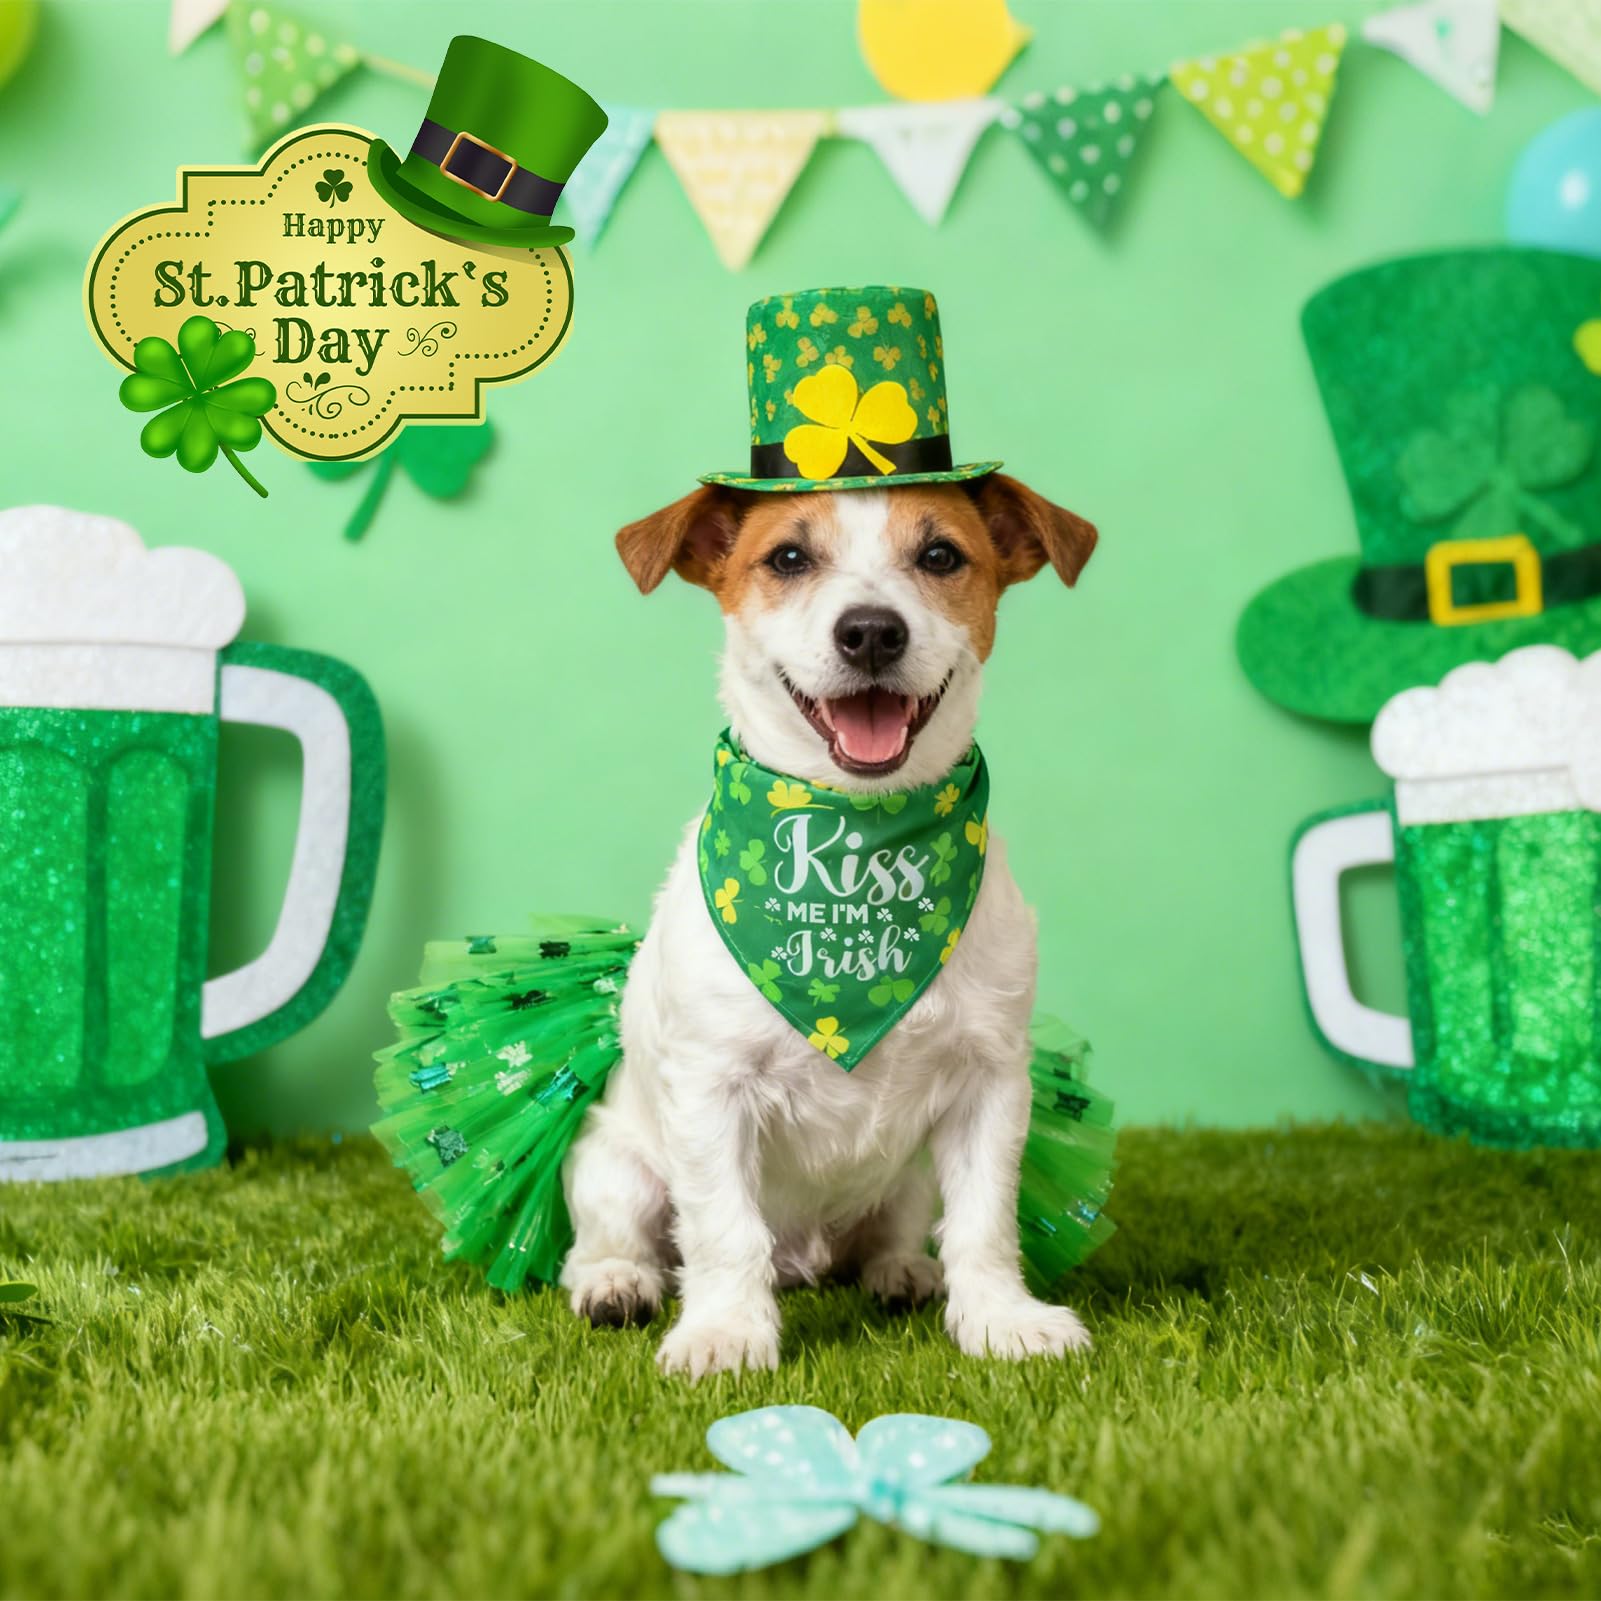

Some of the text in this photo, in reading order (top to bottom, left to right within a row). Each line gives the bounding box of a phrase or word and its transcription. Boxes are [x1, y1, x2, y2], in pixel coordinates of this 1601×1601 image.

[773, 814, 929, 905] Kiss
[787, 901, 869, 924] ME I'M
[786, 924, 912, 981] Irish
